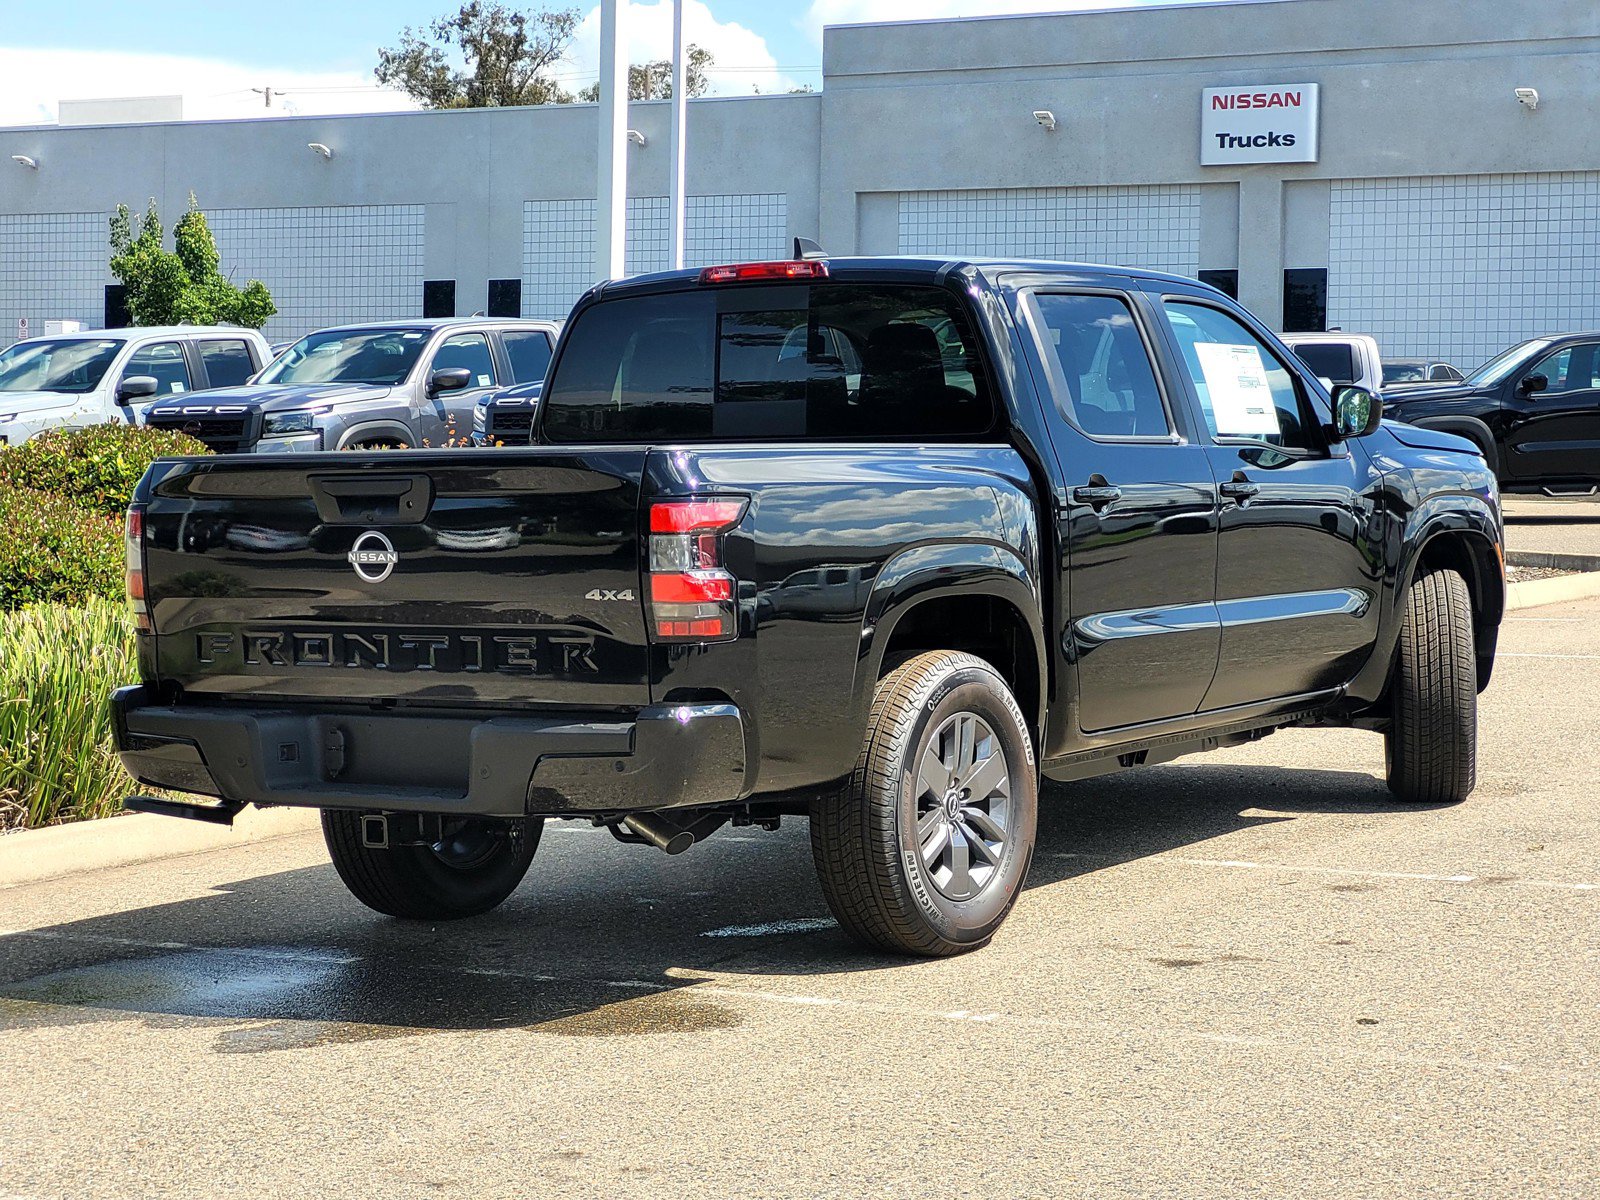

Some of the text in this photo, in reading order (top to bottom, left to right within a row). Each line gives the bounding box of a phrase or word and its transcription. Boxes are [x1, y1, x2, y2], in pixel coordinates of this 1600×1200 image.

[1212, 91, 1301, 110] NISSAN
[1215, 131, 1296, 149] Trucks
[348, 552, 397, 562] NISSAN
[196, 631, 599, 674] FRONTIER
[1004, 695, 1034, 762] MICHELIN
[905, 854, 941, 921] MICHELIN
